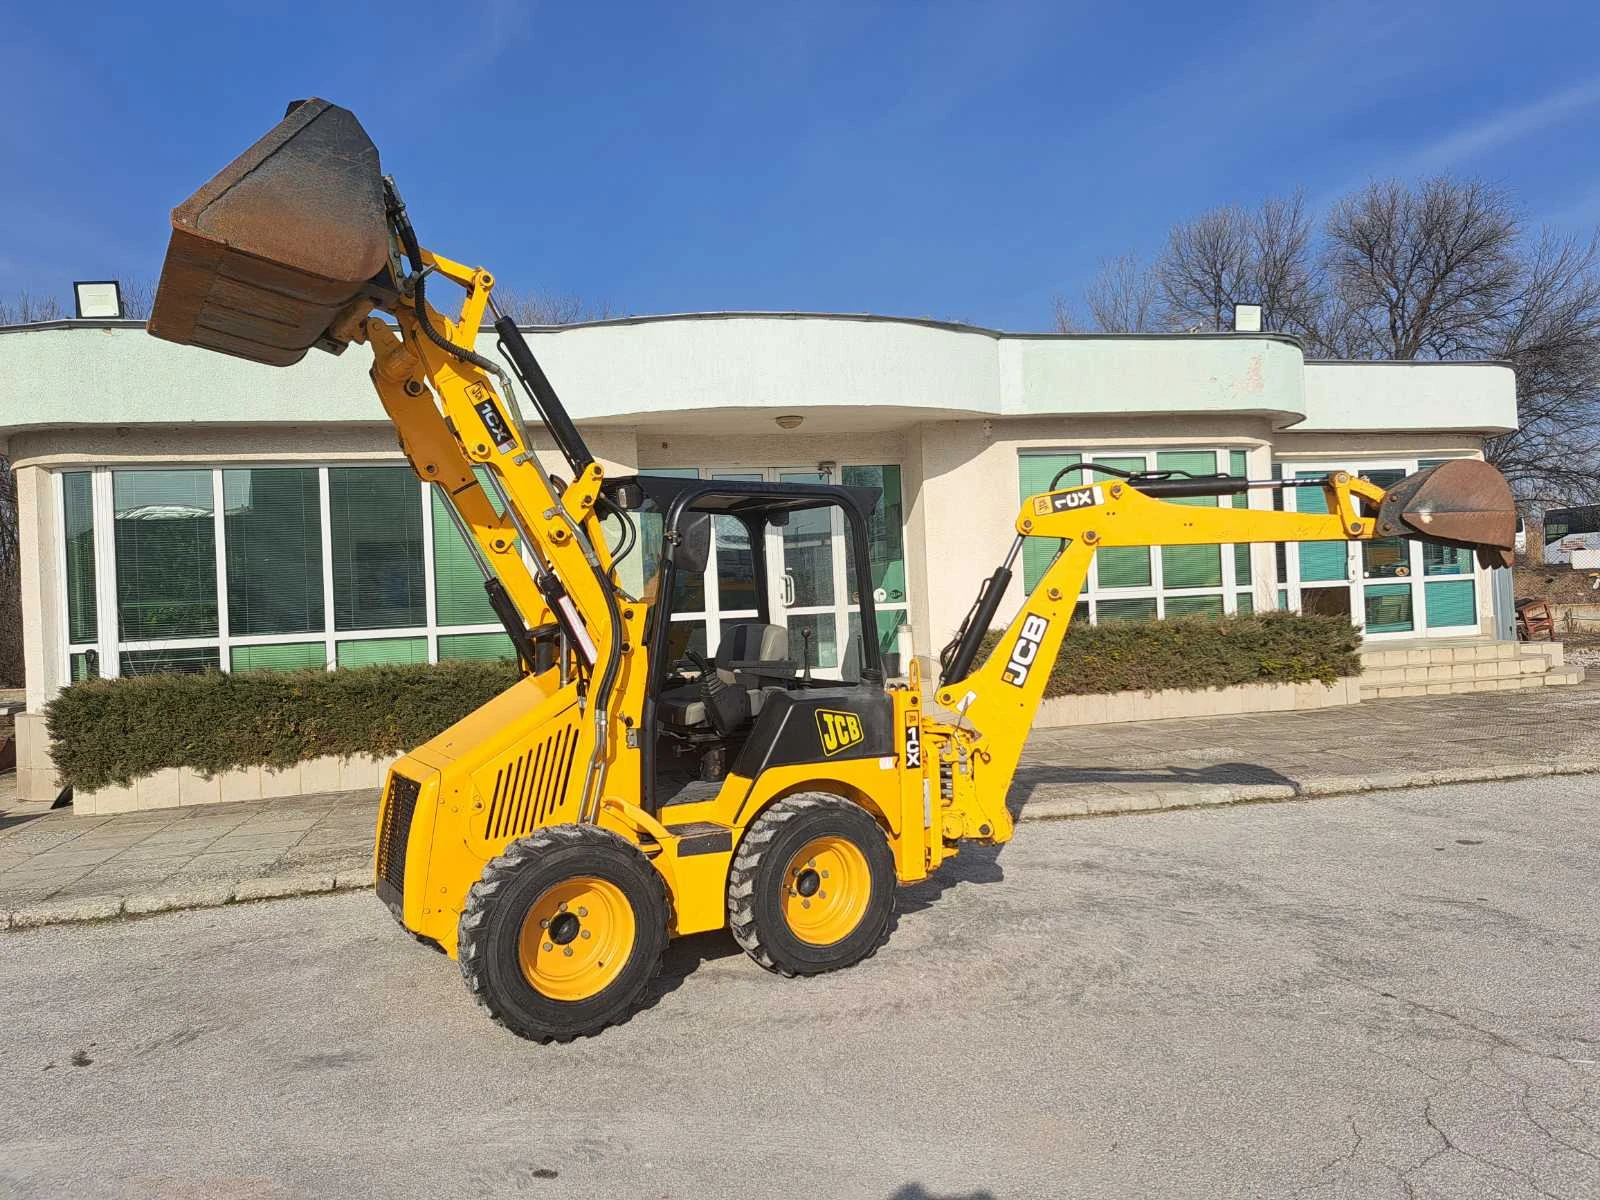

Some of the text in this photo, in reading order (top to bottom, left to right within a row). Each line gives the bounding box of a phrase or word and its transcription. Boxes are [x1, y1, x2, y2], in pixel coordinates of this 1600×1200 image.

[480, 403, 510, 443] 1CX
[1054, 490, 1092, 509] 1CX
[1007, 615, 1049, 686] JCB
[822, 713, 860, 751] JCB
[906, 726, 920, 767] 1CX
